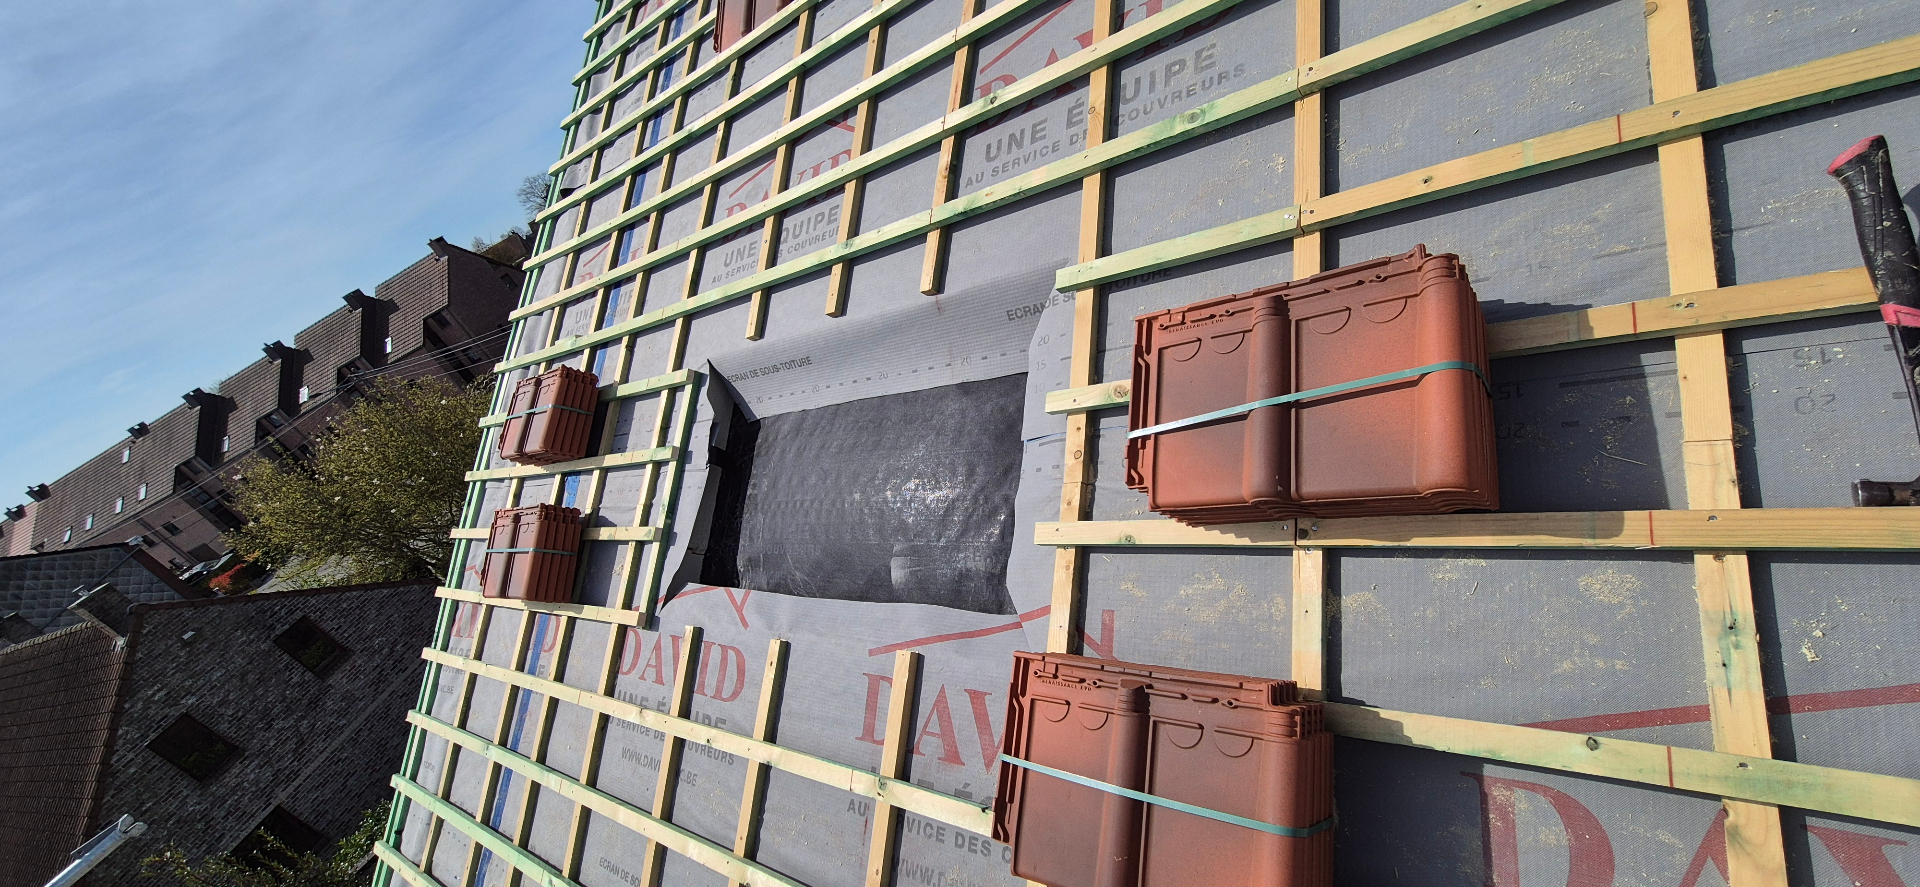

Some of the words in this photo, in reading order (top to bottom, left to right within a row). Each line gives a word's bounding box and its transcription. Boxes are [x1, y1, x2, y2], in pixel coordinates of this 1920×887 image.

[965, 172, 984, 188] AU
[991, 140, 1060, 177] SERVICE
[1070, 128, 1088, 146] DE
[1114, 63, 1246, 127] COUVREURS
[985, 117, 1048, 163] UNE
[1066, 42, 1217, 130] ÉUIPE
[711, 274, 723, 285] AU
[725, 259, 759, 279] SERVIC
[787, 226, 840, 255] COUVREU
[723, 240, 758, 267] UNE
[778, 204, 840, 246] QUIPE
[960, 356, 972, 366] 20
[1037, 335, 1050, 346] 20
[726, 371, 749, 383] ECRAN
[749, 368, 760, 379] DE
[759, 356, 813, 376] SOUS-TOITURE
[1036, 360, 1047, 371] 15
[855, 672, 1004, 775] DAV
[653, 730, 666, 742] DE
[687, 742, 735, 766] UVREURS
[846, 798, 868, 818] AU
[903, 814, 947, 845] VICE
[954, 831, 993, 858] DES
[619, 868, 630, 883] DE
